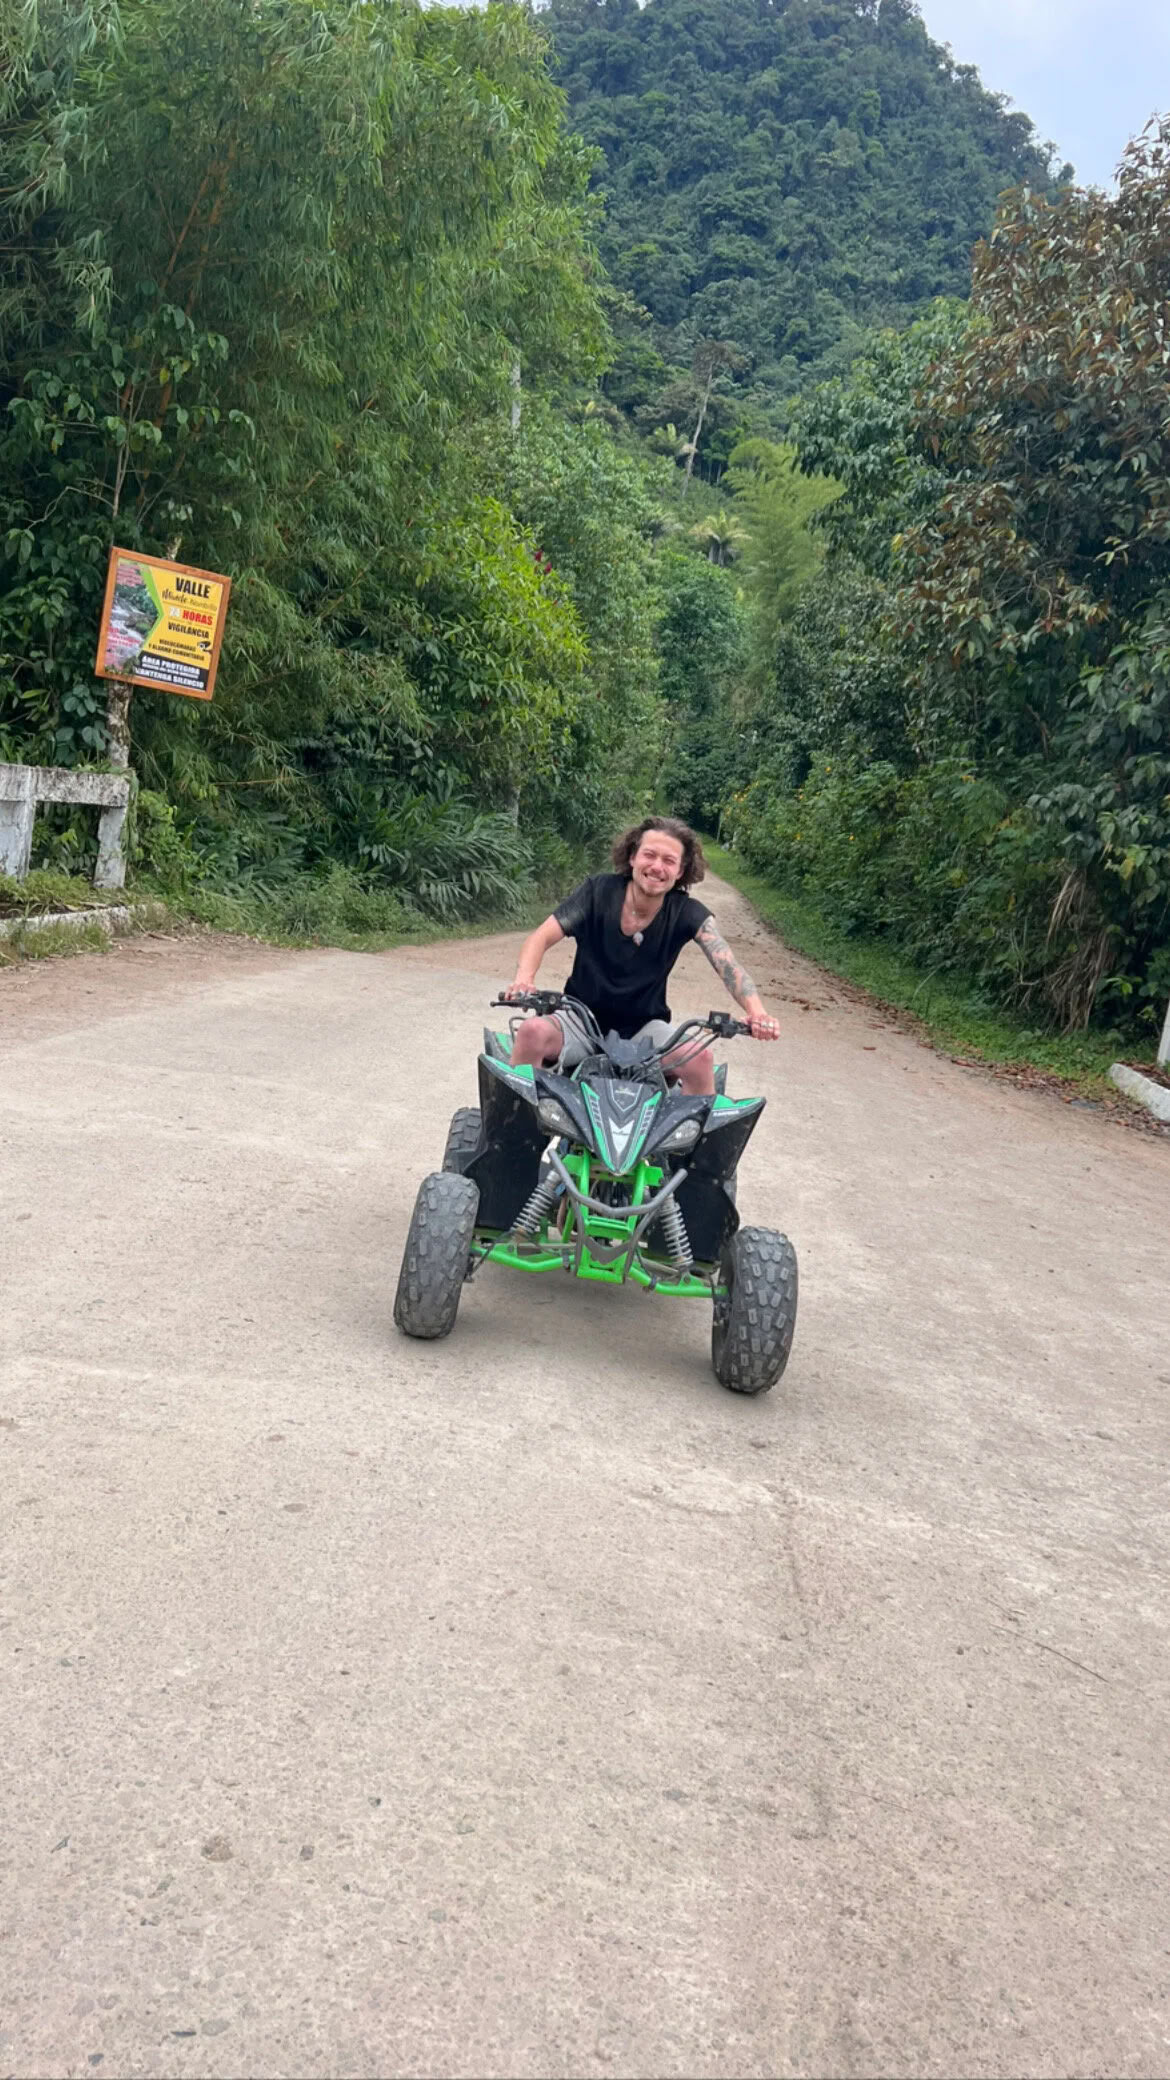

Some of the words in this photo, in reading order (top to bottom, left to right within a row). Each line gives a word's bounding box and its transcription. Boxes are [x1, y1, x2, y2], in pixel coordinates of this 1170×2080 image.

[176, 577, 211, 598] VALLE
[182, 609, 213, 626] HORAS
[168, 622, 209, 639] VIGILANCIA
[173, 675, 204, 688] SILENCIO
